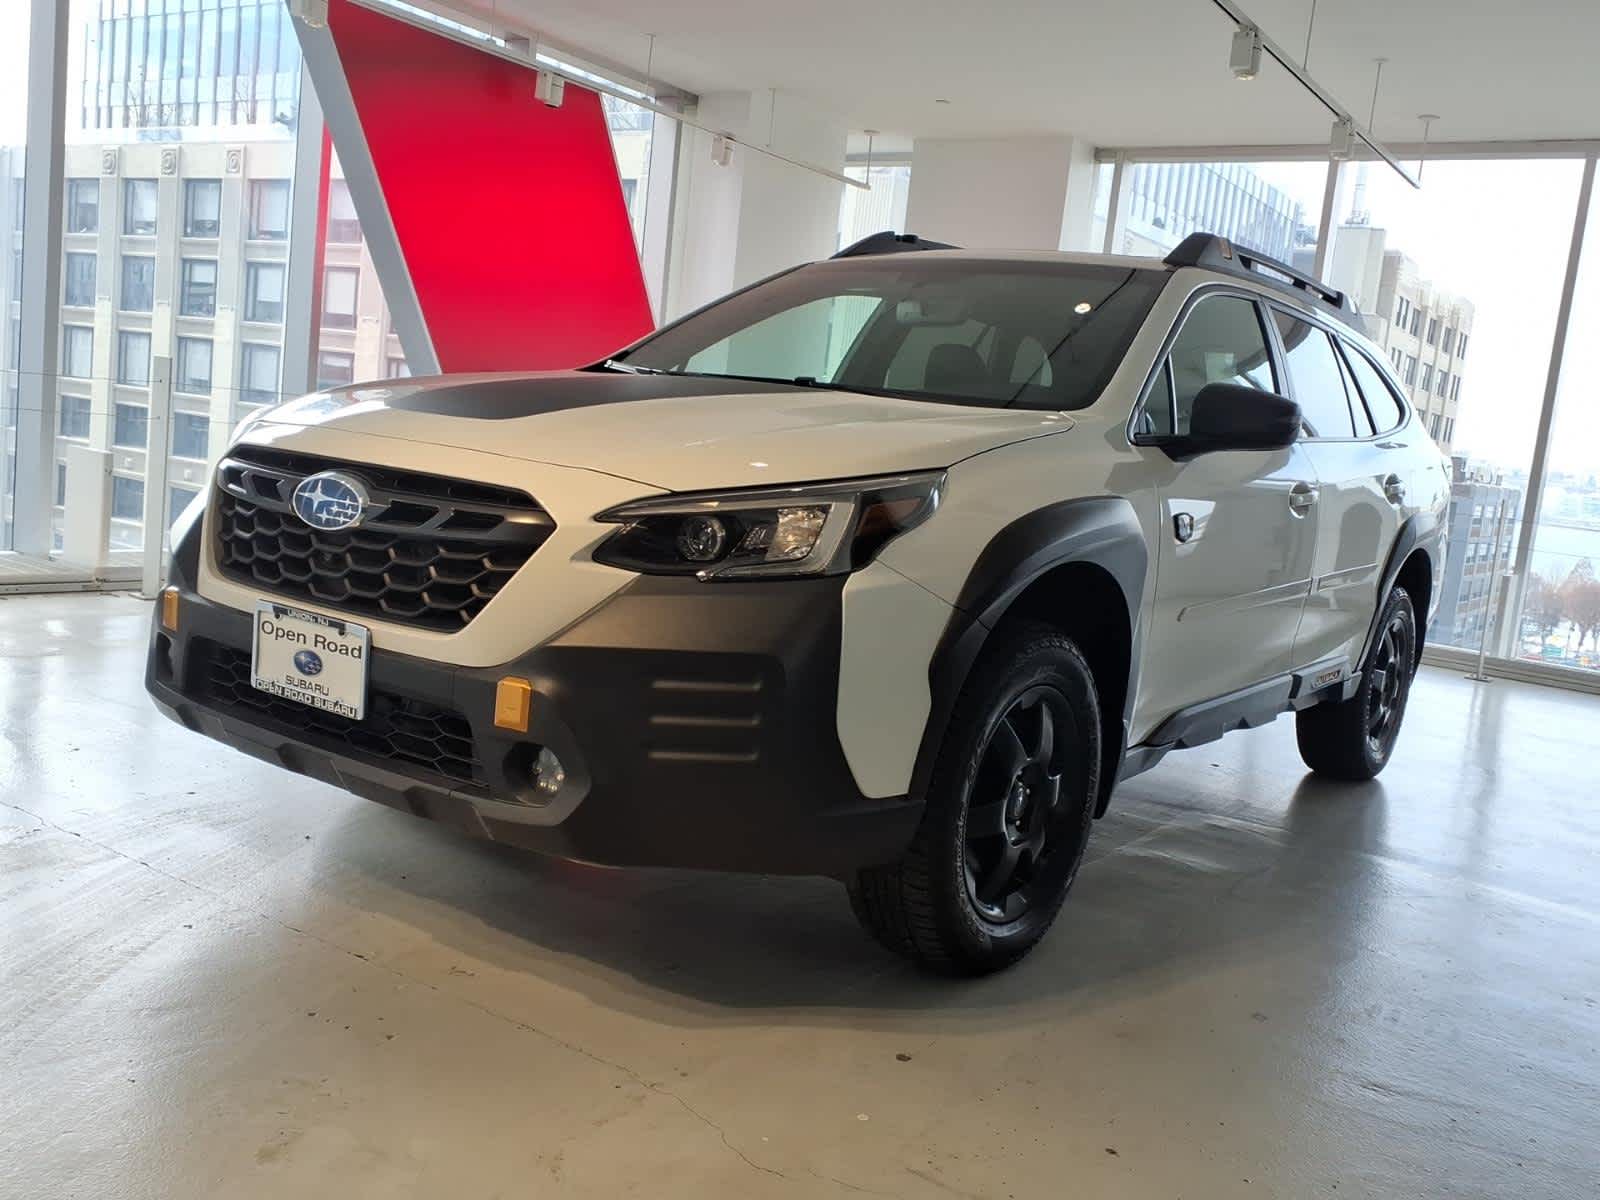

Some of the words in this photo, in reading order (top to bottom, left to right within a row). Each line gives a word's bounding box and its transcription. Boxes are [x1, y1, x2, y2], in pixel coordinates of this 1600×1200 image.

[261, 621, 307, 645] Open
[314, 634, 362, 659] Road
[257, 679, 282, 696] OPEN
[284, 689, 312, 704] ROAD
[314, 697, 356, 717] SUBARU
[285, 675, 330, 696] SUBARU
